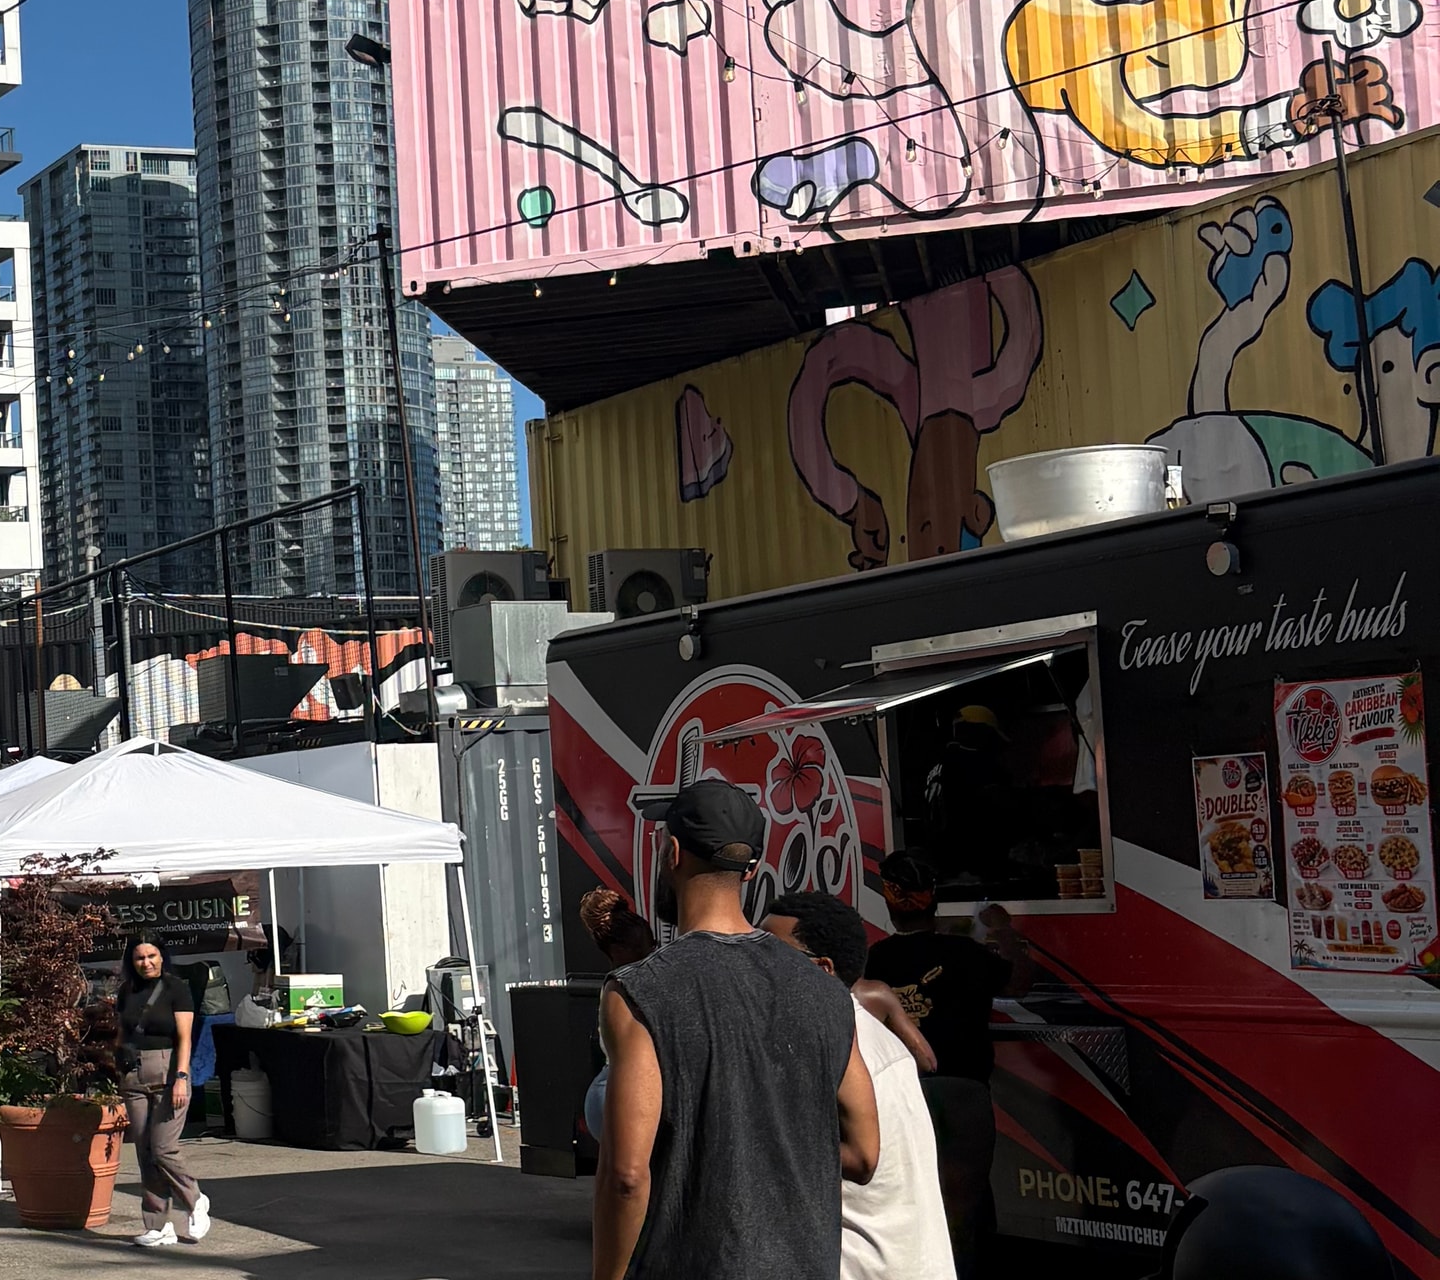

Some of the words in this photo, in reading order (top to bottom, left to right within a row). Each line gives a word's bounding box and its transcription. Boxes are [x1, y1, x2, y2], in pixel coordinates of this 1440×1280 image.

[1118, 617, 1195, 672] Tease
[1188, 616, 1264, 697] your
[1264, 592, 1334, 653] taste
[1335, 570, 1410, 644] buds
[1344, 691, 1399, 718] CARIBBEAN
[1352, 683, 1385, 700] AUTHENTIC
[1348, 707, 1396, 733] FLAVOUR
[1204, 793, 1259, 820] DOUBLES
[116, 903, 158, 924] ESS
[162, 895, 251, 922] CUISINE
[1018, 1167, 1120, 1209] PHONE:
